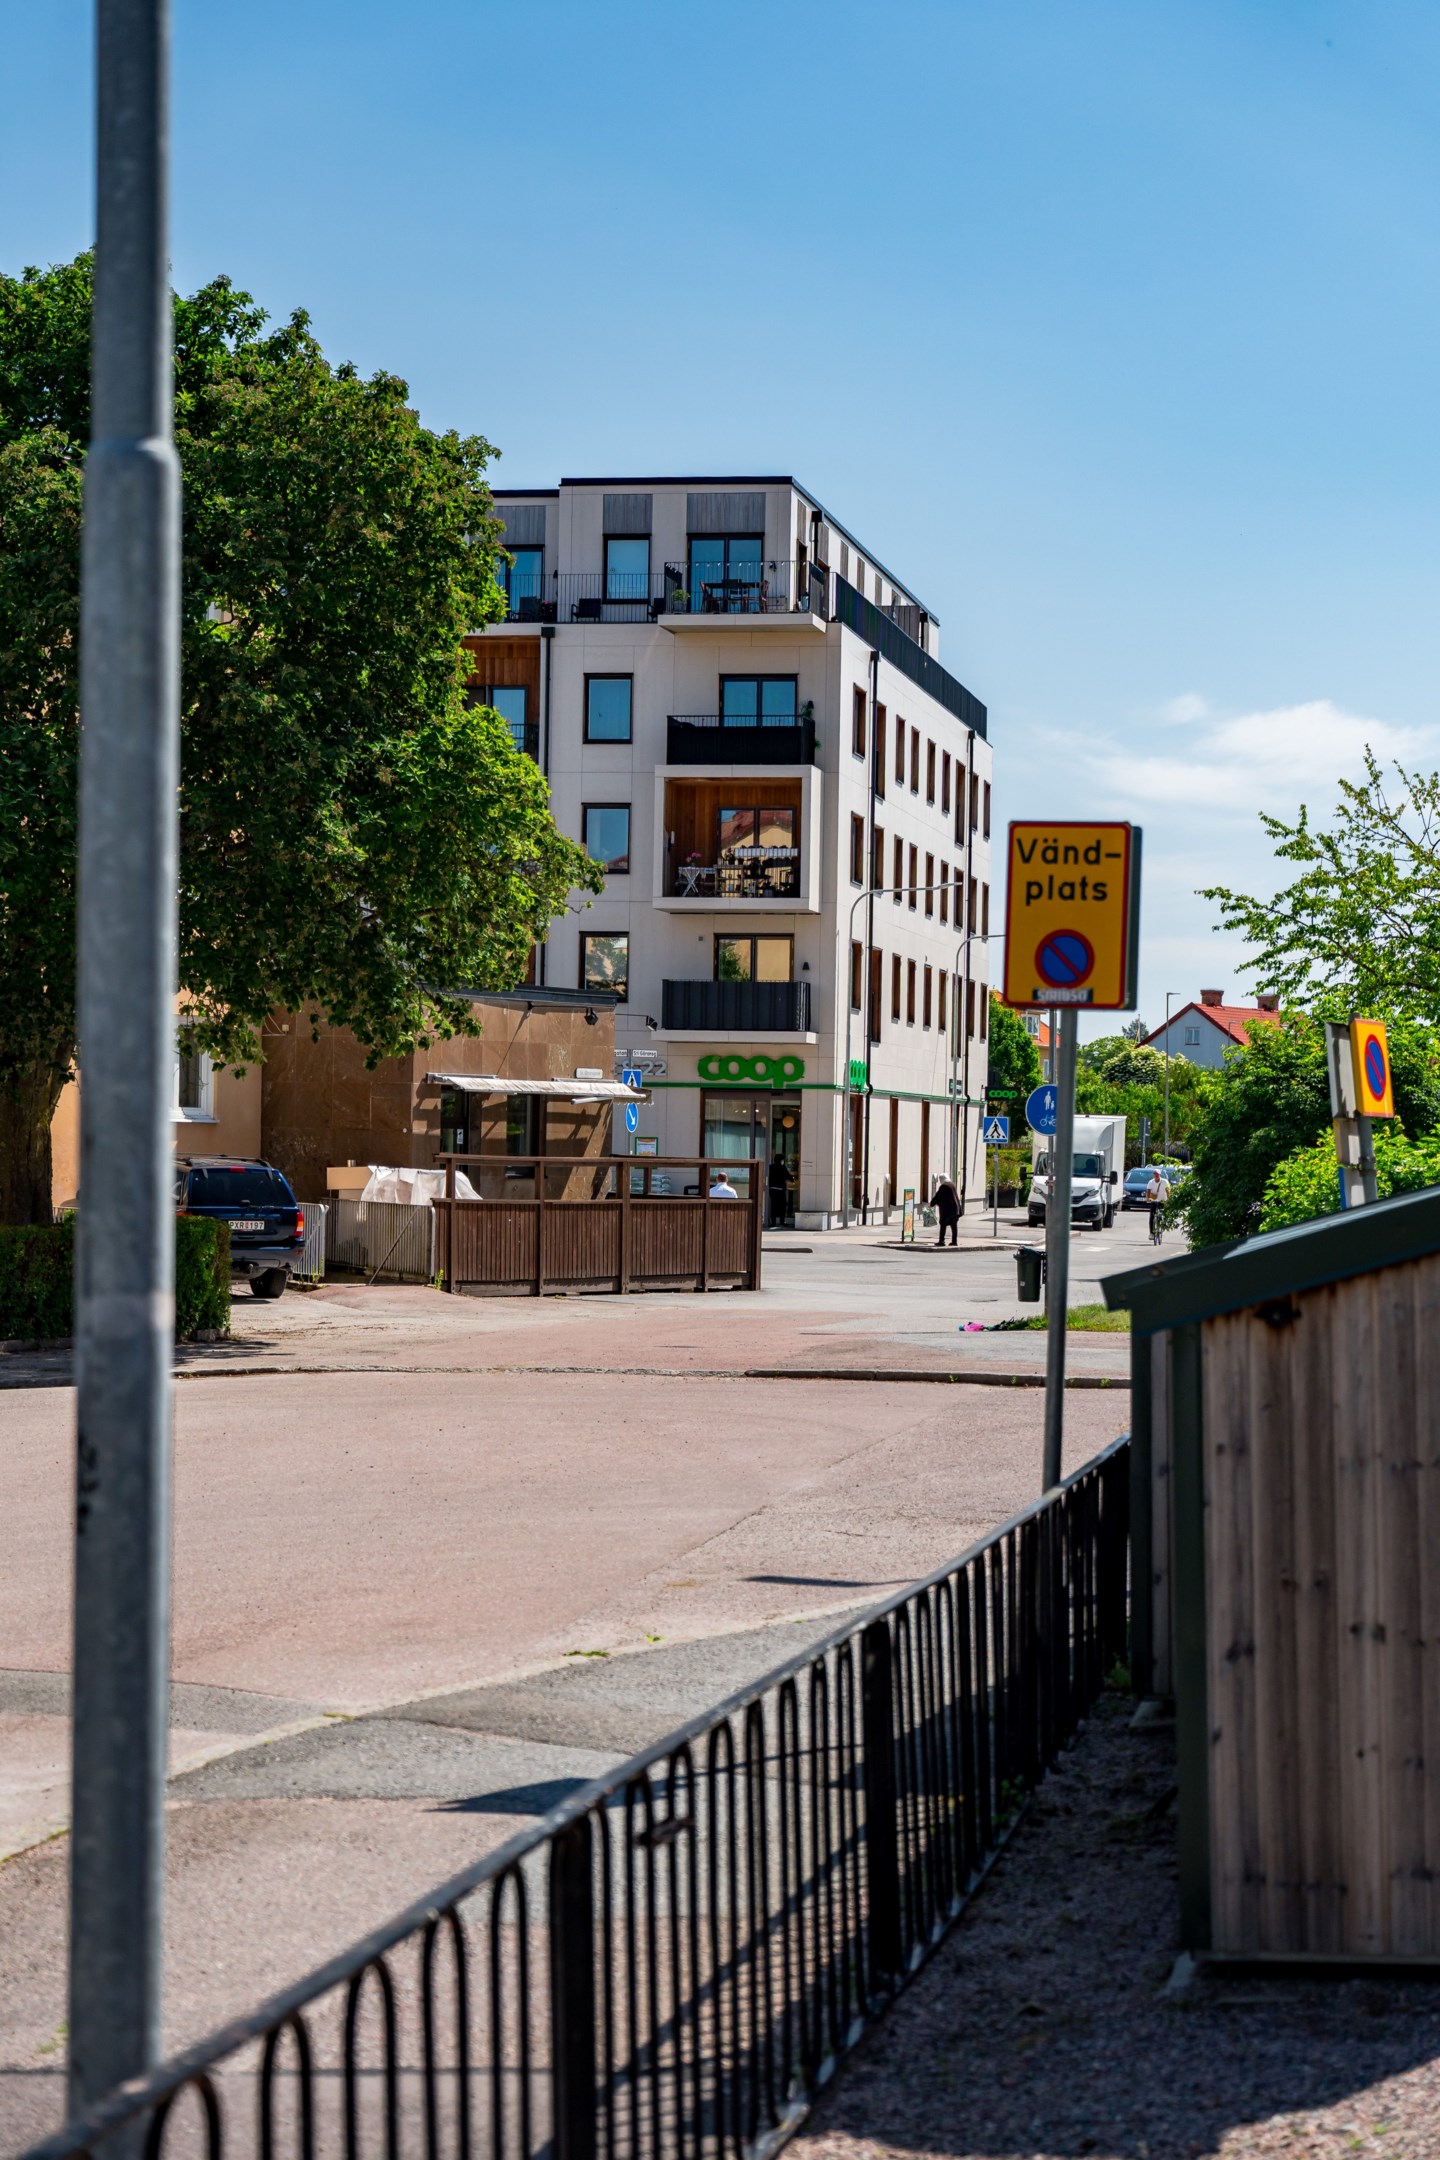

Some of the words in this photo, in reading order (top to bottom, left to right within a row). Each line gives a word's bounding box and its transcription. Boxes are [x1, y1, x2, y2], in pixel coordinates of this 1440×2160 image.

[1016, 837, 1121, 865] Vänd-
[1026, 875, 1107, 906] plats
[698, 1055, 804, 1088] coop
[989, 1090, 1018, 1099] coop
[250, 1221, 264, 1229] 197
